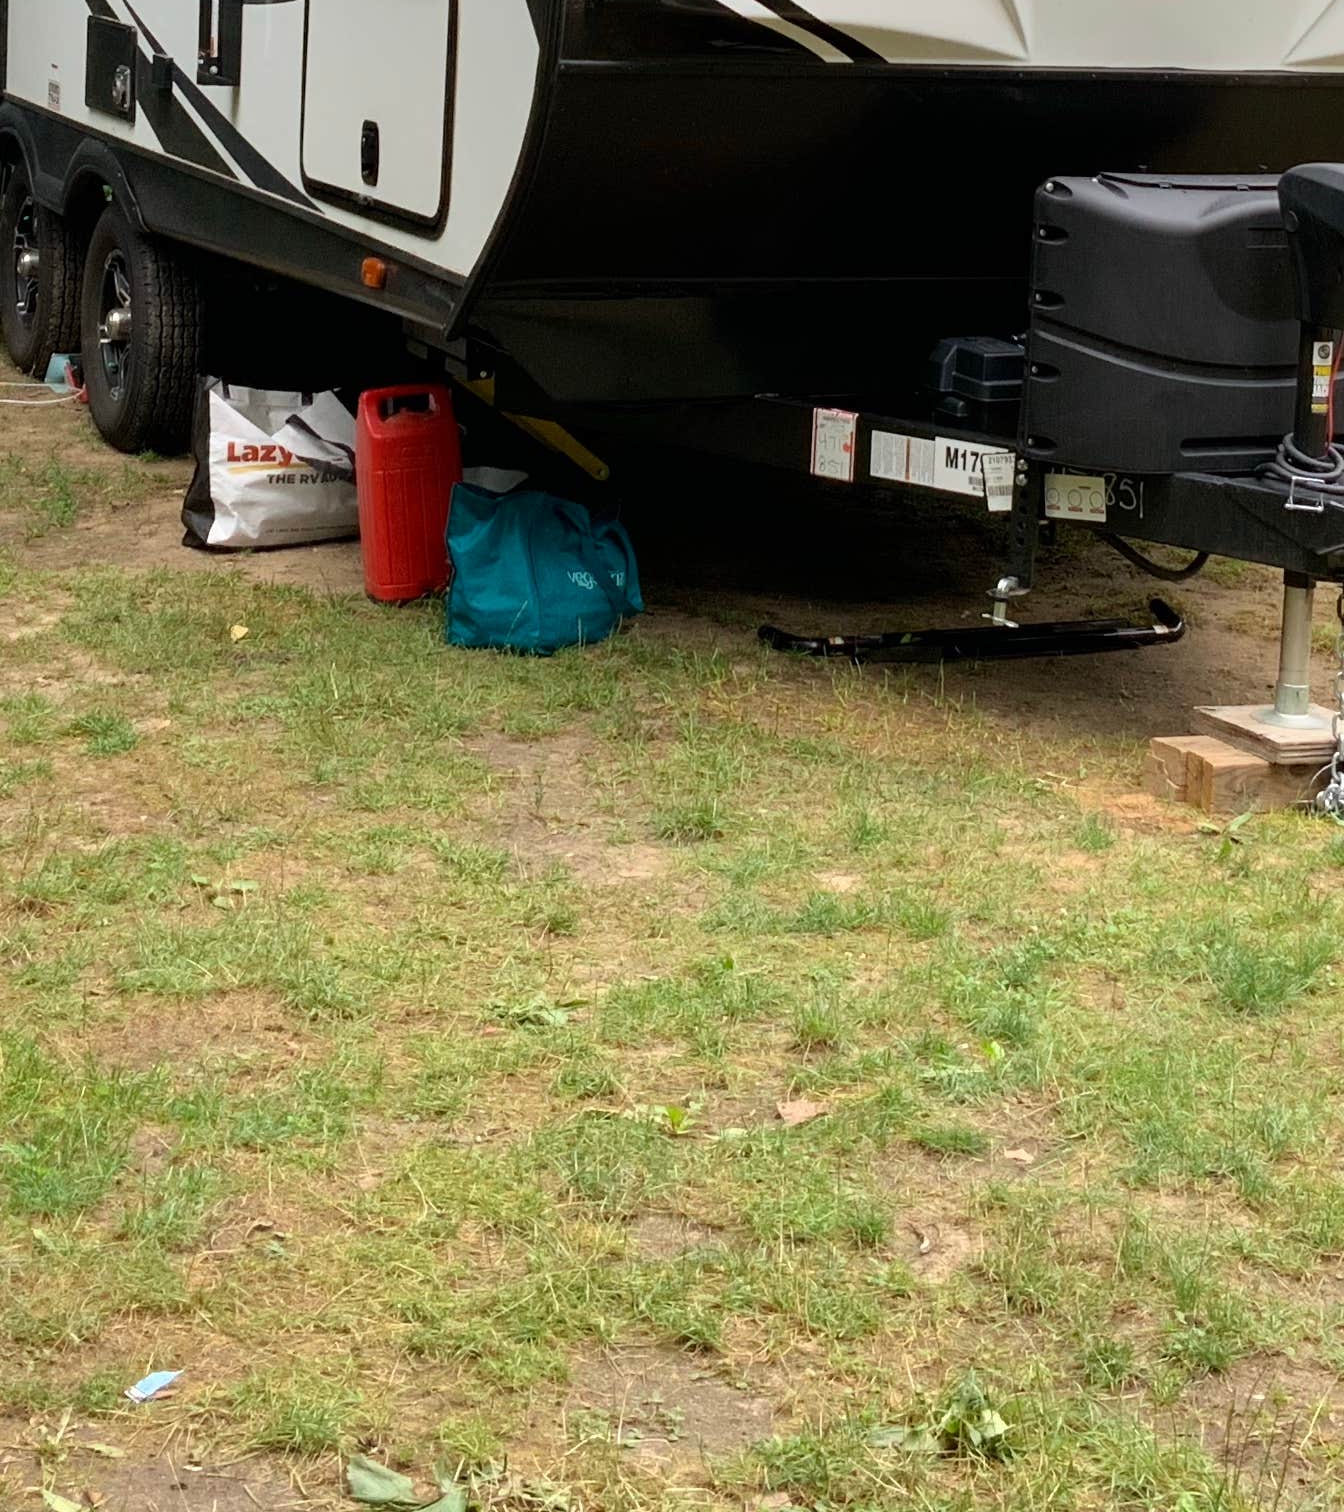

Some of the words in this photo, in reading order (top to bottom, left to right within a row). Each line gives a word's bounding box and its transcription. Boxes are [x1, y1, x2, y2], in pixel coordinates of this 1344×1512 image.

[946, 446, 983, 473] M17
[267, 473, 296, 484] THE
[299, 473, 320, 484] RV
[1104, 472, 1144, 519] 851
